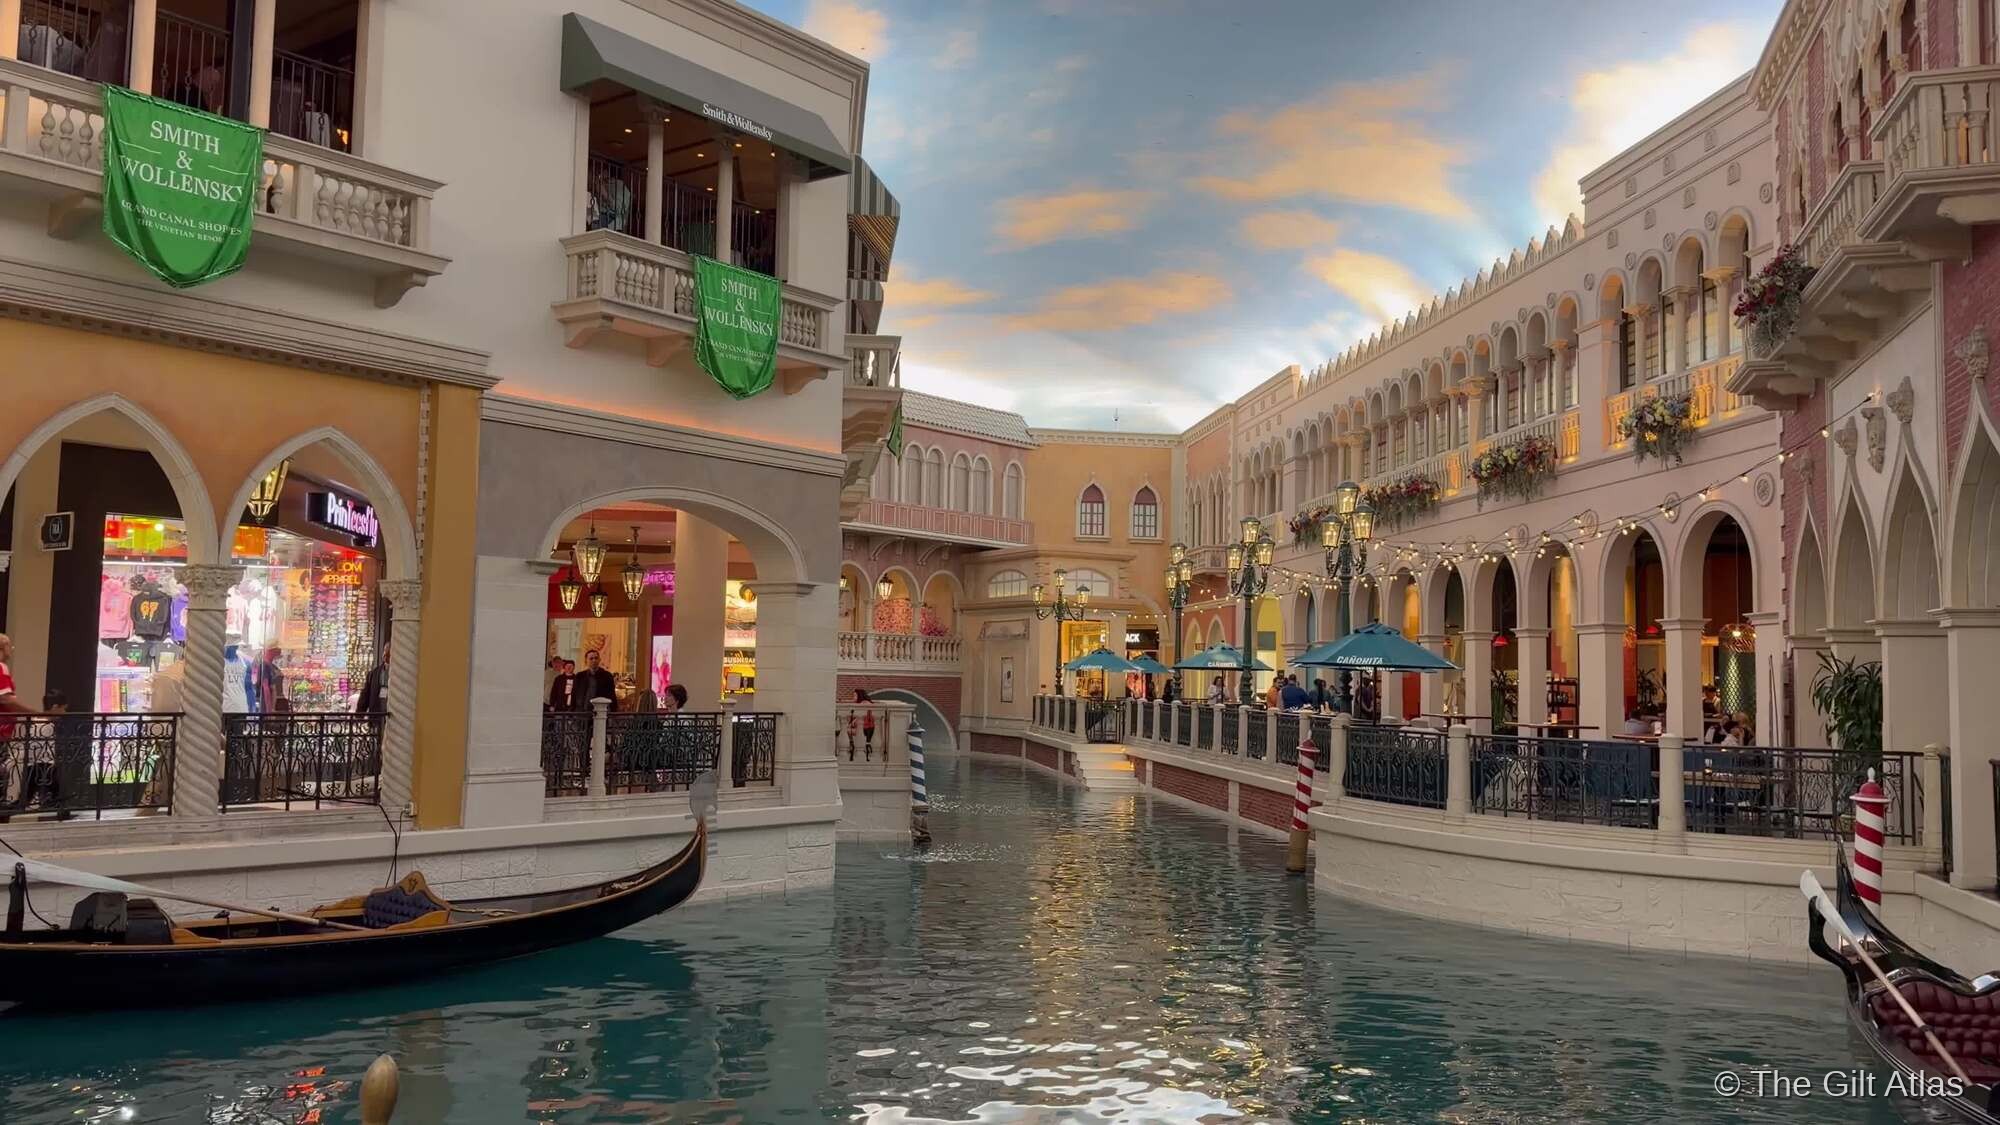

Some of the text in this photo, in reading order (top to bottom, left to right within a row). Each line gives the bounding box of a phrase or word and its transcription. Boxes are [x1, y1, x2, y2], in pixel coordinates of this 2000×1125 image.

[703, 103, 727, 122] Smith
[734, 115, 773, 141] Wollensky
[150, 120, 220, 155] SMITH
[176, 150, 193, 171] &
[119, 155, 243, 202] WOLLENSKY
[159, 211, 197, 229] CANAL
[198, 220, 242, 236] SHOPES
[197, 231, 223, 243] RESO
[721, 278, 758, 300] SMITH
[734, 297, 746, 313] &
[704, 305, 774, 336] WOLLENSKY
